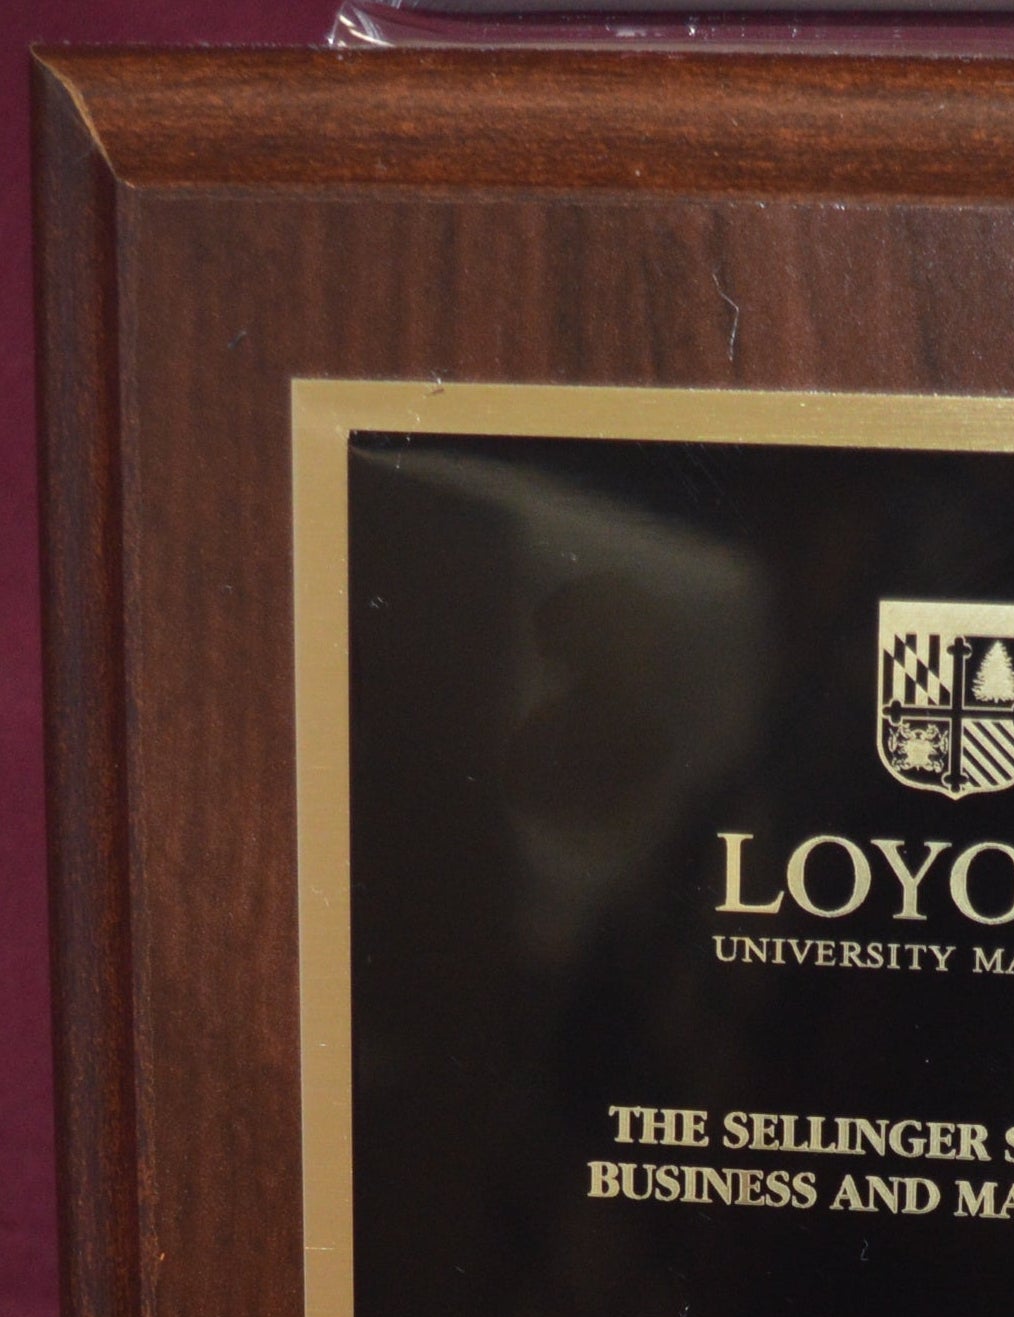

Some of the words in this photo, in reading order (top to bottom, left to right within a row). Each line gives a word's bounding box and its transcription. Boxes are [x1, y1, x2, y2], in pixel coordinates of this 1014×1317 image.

[712, 936, 956, 971] UNIVERSITY
[609, 1106, 709, 1147] THE
[723, 1111, 991, 1161] SELLINGER
[587, 1161, 817, 1208] BUSINESS
[830, 1174, 940, 1214] AND
